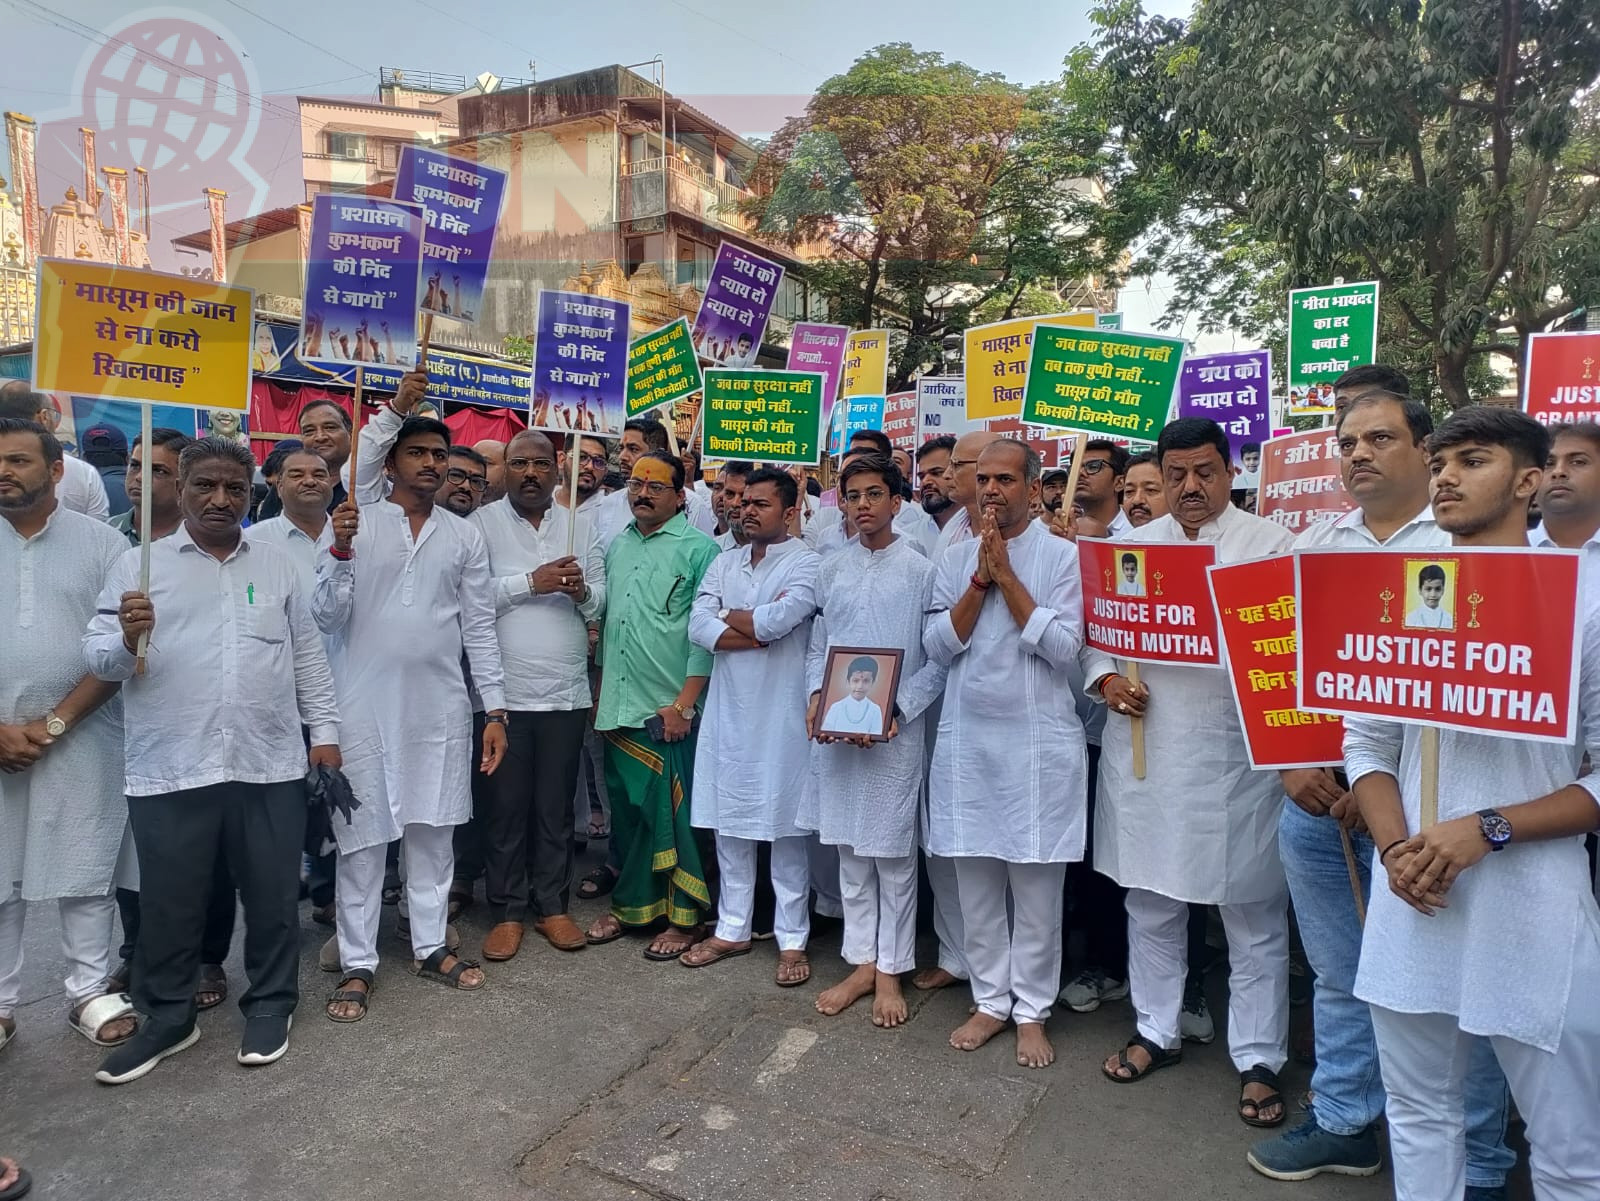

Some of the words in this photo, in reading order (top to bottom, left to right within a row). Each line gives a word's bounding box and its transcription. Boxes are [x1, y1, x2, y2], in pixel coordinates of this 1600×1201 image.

[427, 160, 488, 191] प्रशासन
[412, 184, 483, 215] कुम्भकर्ण
[341, 206, 406, 228] प्रशासन
[440, 214, 471, 236] निंद
[328, 232, 402, 254] कुम्भकर्ण
[333, 256, 357, 276] की
[360, 258, 393, 279] निंद
[733, 254, 757, 278] ग्रंथ
[757, 266, 777, 286] को
[322, 285, 340, 305] से
[342, 290, 387, 309] जागों
[720, 275, 752, 299] न्याय
[751, 286, 768, 305] दो
[1301, 296, 1330, 310] मीरा
[1332, 290, 1374, 307] भायंदर
[75, 282, 149, 313] मासूम
[154, 290, 187, 315] की
[191, 298, 237, 323] जान
[564, 301, 616, 320] प्रशासन
[706, 298, 738, 321] न्याय
[738, 309, 755, 327] दो
[553, 322, 614, 342] कुम्भकर्ण
[1313, 317, 1332, 329] का
[1333, 316, 1350, 328] हर
[95, 316, 119, 342] से
[124, 324, 154, 346] ना
[158, 328, 201, 352] करो
[858, 339, 879, 350] जान
[982, 333, 1021, 354] मासूम
[1340, 333, 1351, 348] है
[558, 343, 578, 359] की
[580, 344, 606, 363] निंद
[1055, 337, 1076, 349] जब
[1078, 339, 1099, 352] तक
[1101, 342, 1141, 359] सुरक्षा
[1142, 346, 1174, 363] नहीं
[92, 351, 187, 388] खिलवाड़
[550, 366, 564, 383] से
[655, 369, 667, 381] की
[993, 360, 1006, 377] से
[1009, 360, 1026, 375] ना
[1044, 359, 1063, 373] तब
[1064, 361, 1086, 375] तक
[1198, 360, 1231, 383] ग्रंथ
[1234, 358, 1263, 379] को
[1301, 358, 1350, 374] अनमोल
[716, 378, 732, 390] जब
[733, 378, 752, 390] तक
[753, 380, 787, 394] सुरक्षा
[789, 379, 814, 394] नहीं
[922, 383, 956, 395] आखिर
[993, 386, 1024, 403] खिल
[1055, 383, 1090, 402] मासूम
[1092, 387, 1112, 402] की
[1114, 389, 1142, 407] मौत
[1190, 390, 1234, 408] न्याय
[1237, 386, 1258, 405] दो
[711, 398, 724, 411] तब
[725, 399, 743, 411] तक
[720, 419, 750, 434] मासूम
[751, 418, 768, 432] की
[770, 419, 795, 434] मौत
[925, 413, 941, 426] NO
[1034, 401, 1077, 421] किसकी
[1078, 406, 1140, 431] जिम्मेदारी
[1231, 416, 1252, 436] दो
[709, 435, 742, 451] किसकी
[744, 437, 796, 455] जिम्मेदारी
[1284, 440, 1322, 465] और
[1094, 598, 1149, 623] JUSTICE
[1156, 605, 1196, 626] FOR
[1237, 605, 1265, 624] यह
[1088, 622, 1135, 650] GRANTH
[1142, 632, 1213, 656] MUTHA
[1337, 634, 1456, 669] JUSTICE
[1465, 641, 1532, 676] FOR
[1248, 669, 1287, 692] बिन
[1316, 671, 1431, 709] GRANTH
[1442, 683, 1557, 724] MUTHA
